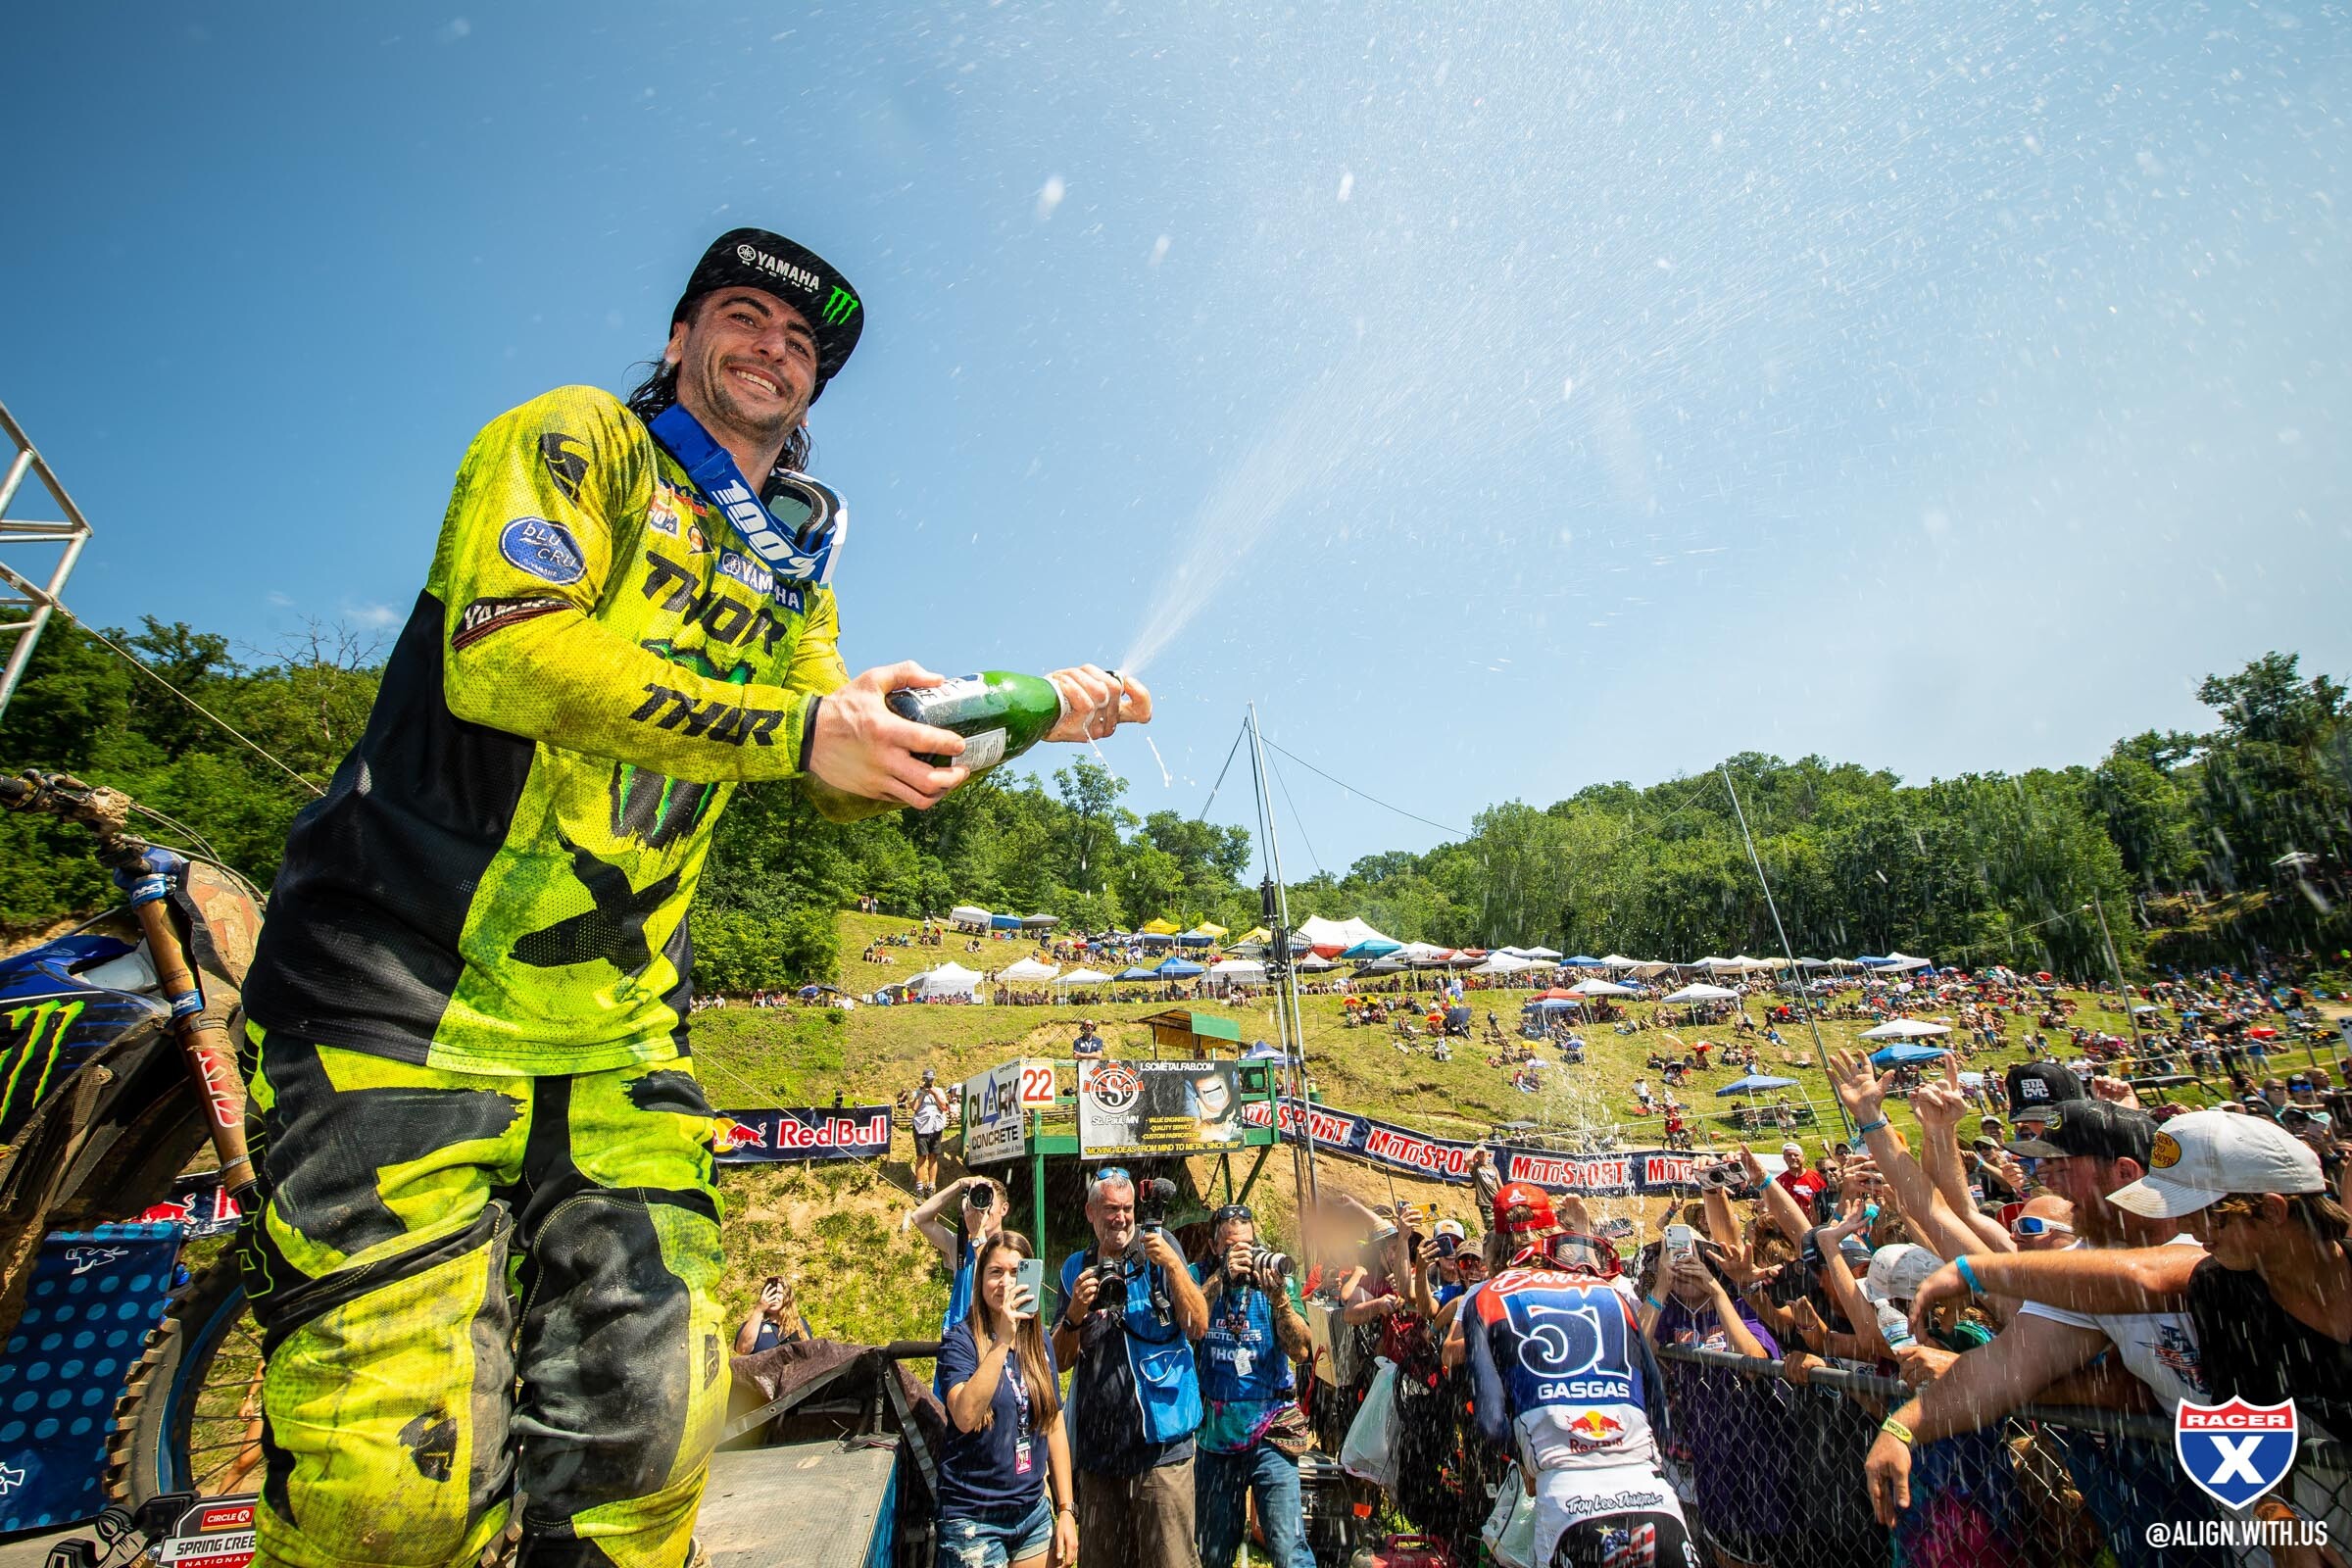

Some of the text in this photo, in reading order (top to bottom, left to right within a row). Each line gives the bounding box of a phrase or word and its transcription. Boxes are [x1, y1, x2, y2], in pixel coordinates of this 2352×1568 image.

[742, 260, 813, 293] RACING
[758, 251, 819, 290] YAMAHA
[711, 479, 825, 579] 100%
[742, 560, 801, 610] YAMHA
[642, 550, 787, 658] THOR
[1140, 1062, 1214, 1071] LSCMETALFAB.COM
[1023, 1069, 1053, 1101] 22
[2021, 1079, 2045, 1089] STA
[778, 1115, 886, 1147] Red Bull
[972, 1125, 1019, 1150] CONCRETE
[1499, 1285, 1632, 1381] 51
[1538, 1381, 1630, 1399] GASGAS
[207, 1513, 236, 1523] CIRCLE
[1566, 1495, 1592, 1515] Troy
[1593, 1494, 1617, 1511] Lee
[175, 1535, 256, 1556] SPRING CREE
[185, 1555, 248, 1567] NATIONAL
